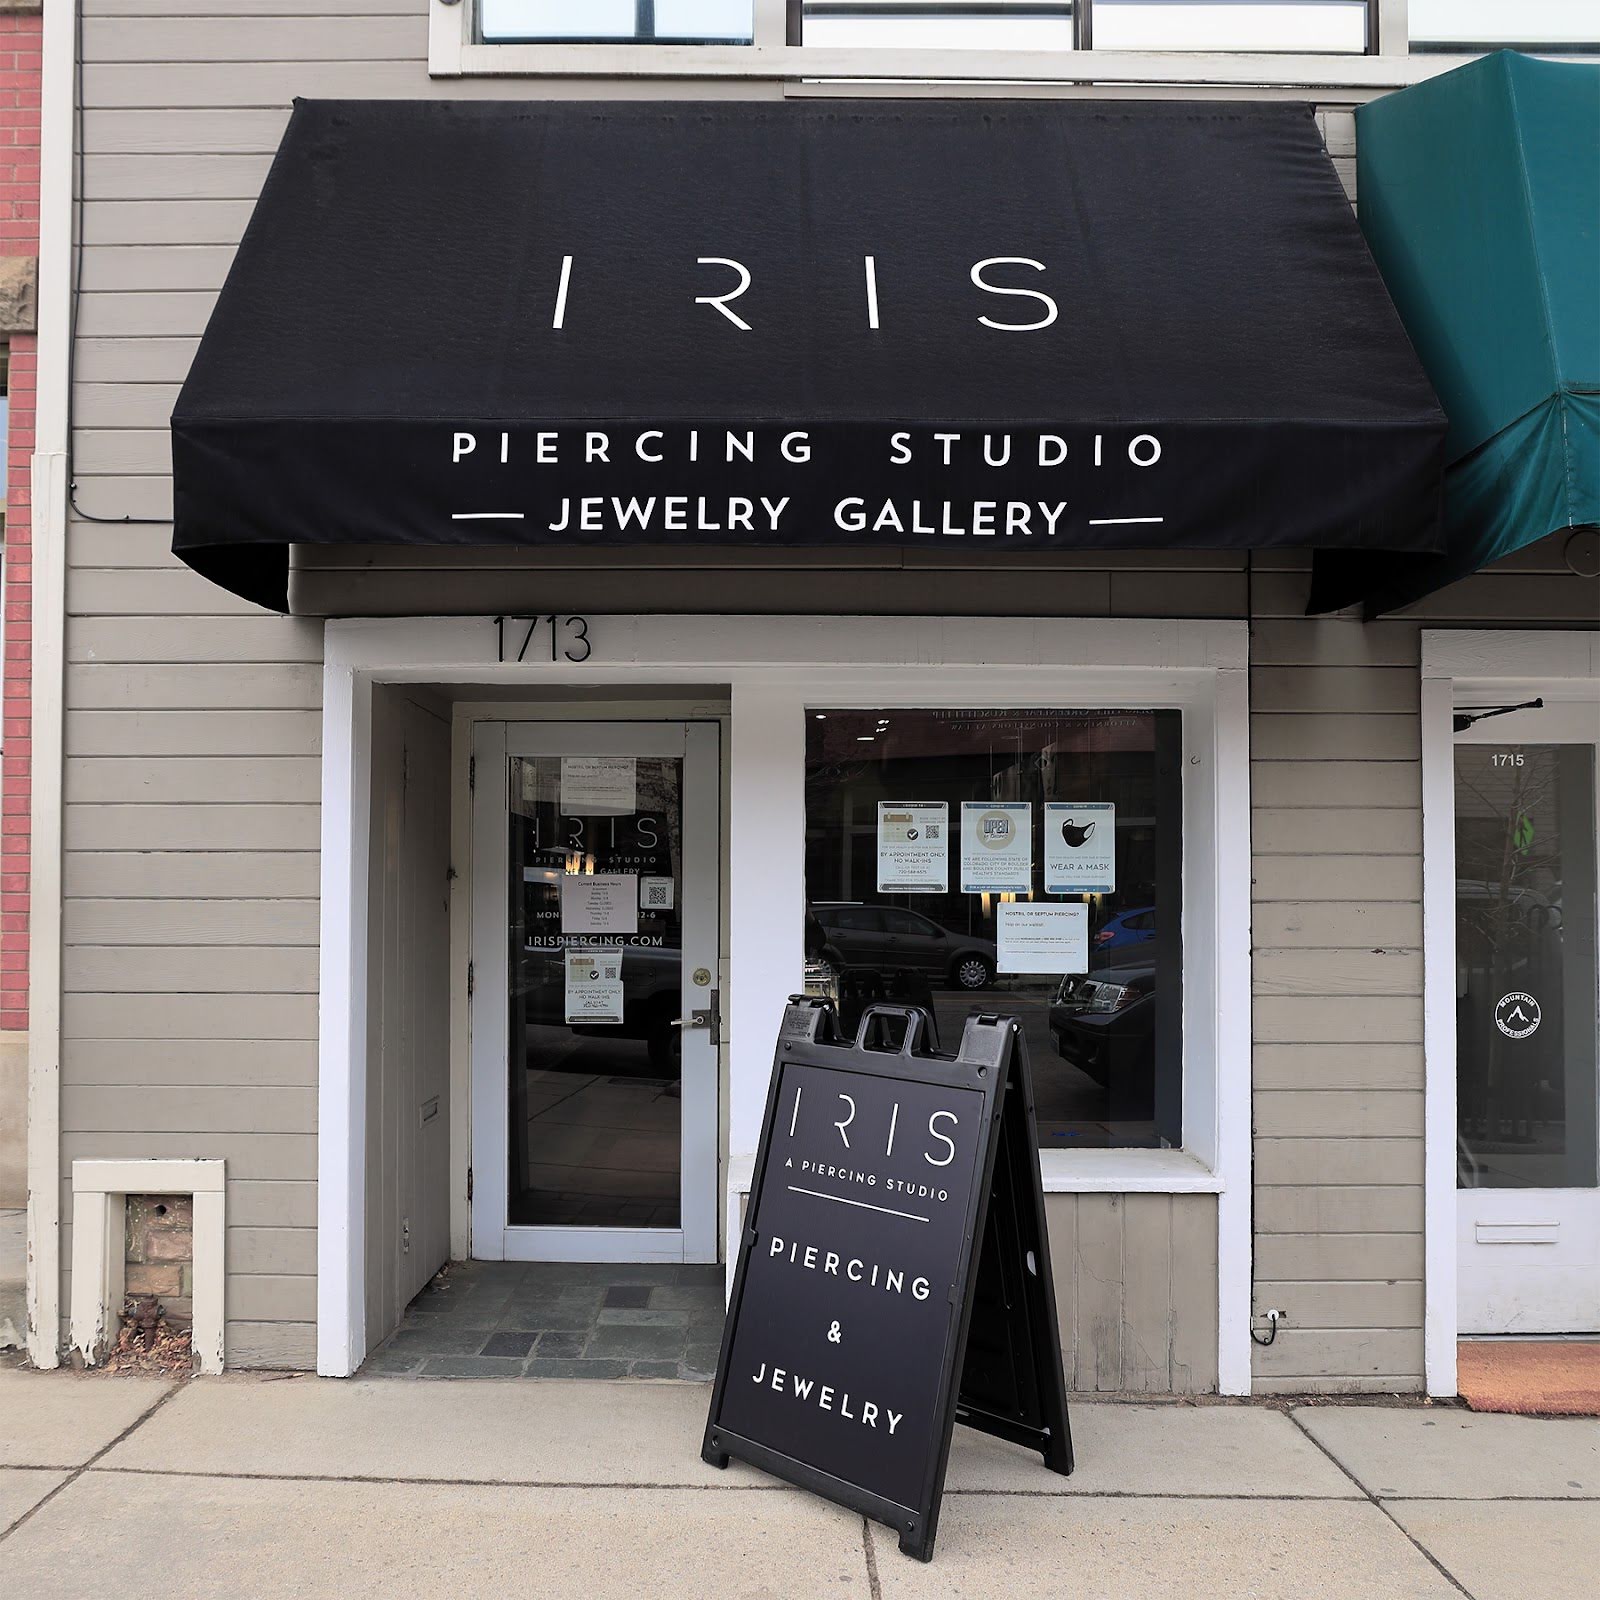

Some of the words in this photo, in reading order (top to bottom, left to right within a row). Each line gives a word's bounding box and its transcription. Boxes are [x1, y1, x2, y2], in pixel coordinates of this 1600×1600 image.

[552, 255, 1059, 332] IRIS
[452, 430, 811, 464] PIERCING
[889, 432, 1162, 467] STUDIO
[548, 496, 791, 532] JEWELRY
[833, 497, 1068, 536] GALLERY
[493, 614, 592, 663] 1713
[1491, 754, 1524, 767] 1715
[536, 817, 658, 849] IRIS
[600, 867, 640, 875] GALLERY
[609, 856, 657, 864] STUDIO
[1049, 863, 1075, 871] WEAR
[1077, 863, 1083, 871] A
[1086, 863, 1110, 871] MASK
[528, 936, 663, 946] IRISPIERCING.COM
[1499, 994, 1535, 1008] MOUNTAIN
[1497, 1017, 1539, 1037] PROFESSIONALS
[789, 1087, 959, 1168] IRIS
[784, 1157, 793, 1168] A
[801, 1160, 877, 1187] PIERCING
[886, 1178, 949, 1202] STUDIO
[769, 1236, 931, 1301] PIERCING
[827, 1320, 842, 1344] &
[752, 1362, 904, 1435] JEWELRY
